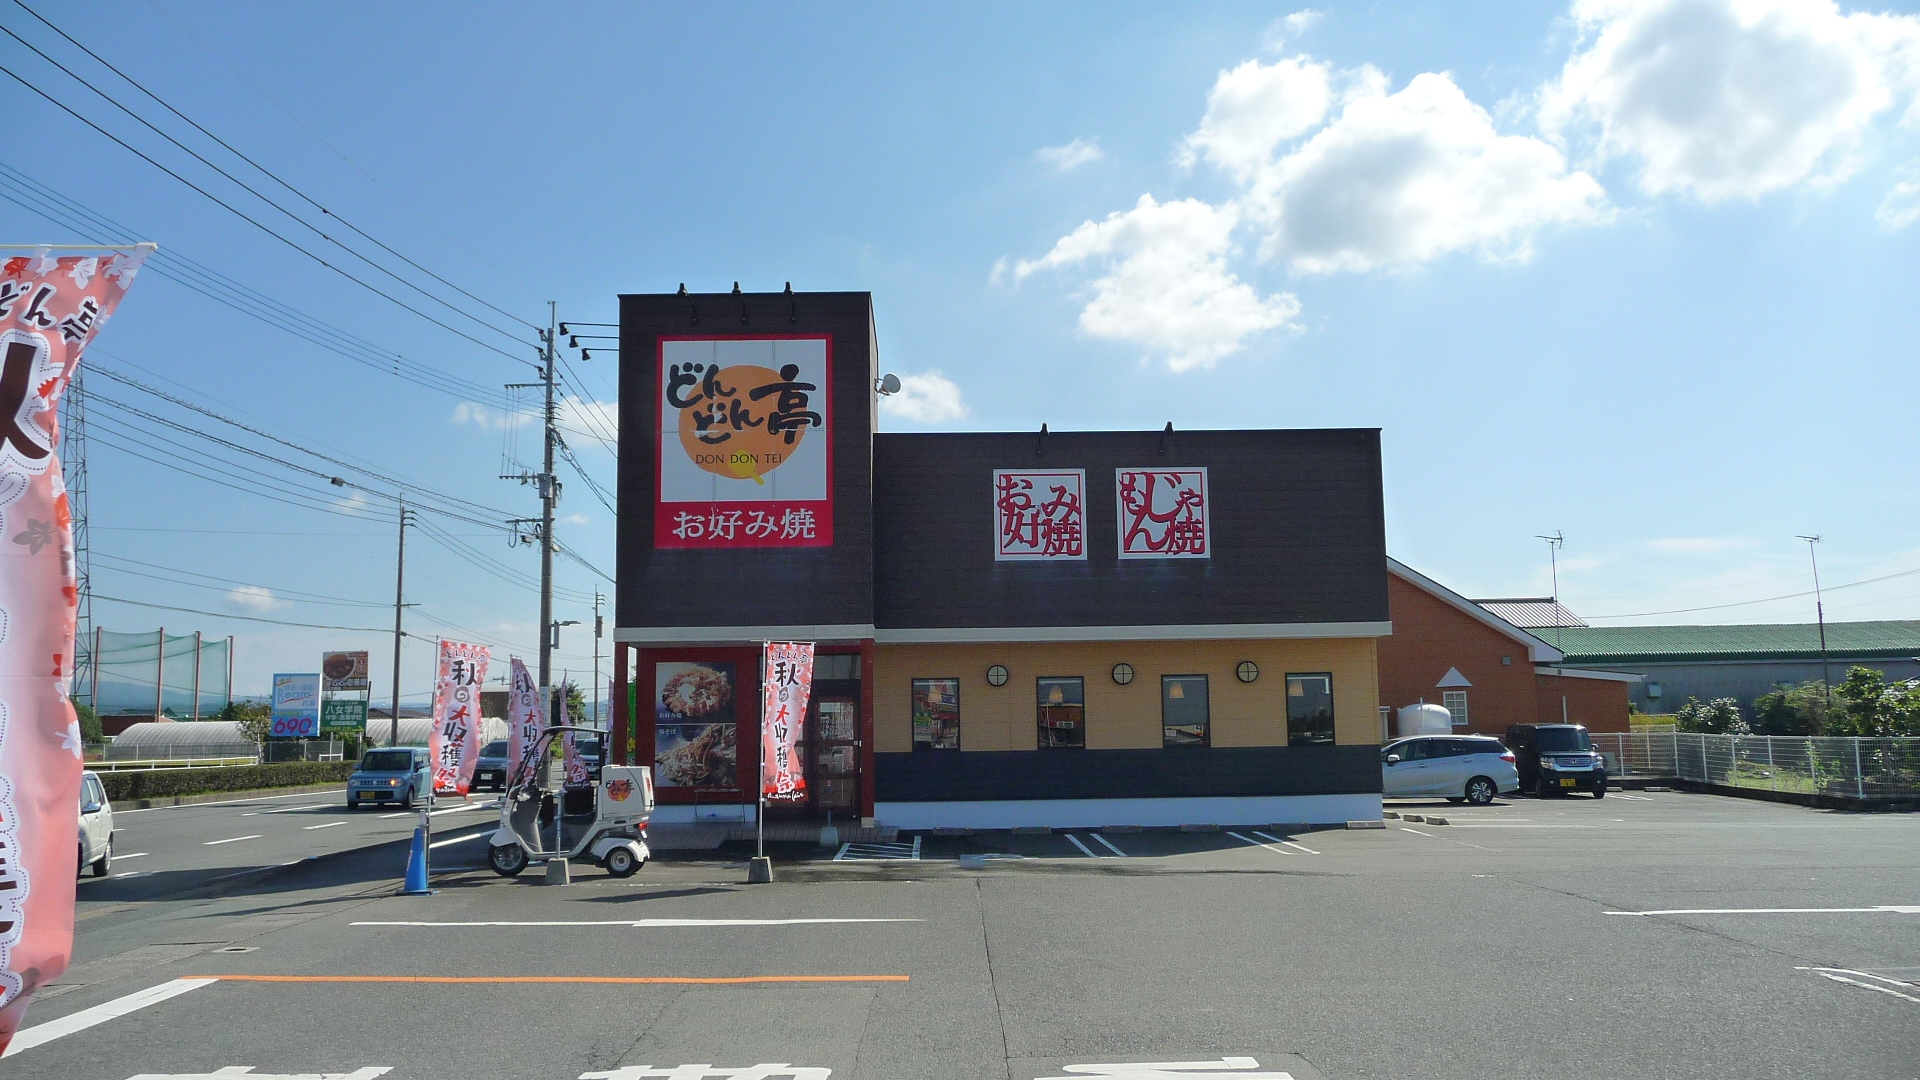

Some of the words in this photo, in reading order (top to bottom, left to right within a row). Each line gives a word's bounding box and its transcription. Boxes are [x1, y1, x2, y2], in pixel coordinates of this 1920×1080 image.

[695, 454, 724, 464] DON
[730, 453, 758, 464] DON
[765, 453, 782, 464] TEI
[672, 507, 816, 540] お好み焼
[325, 705, 363, 714] 八女学院
[274, 717, 312, 734] 690
